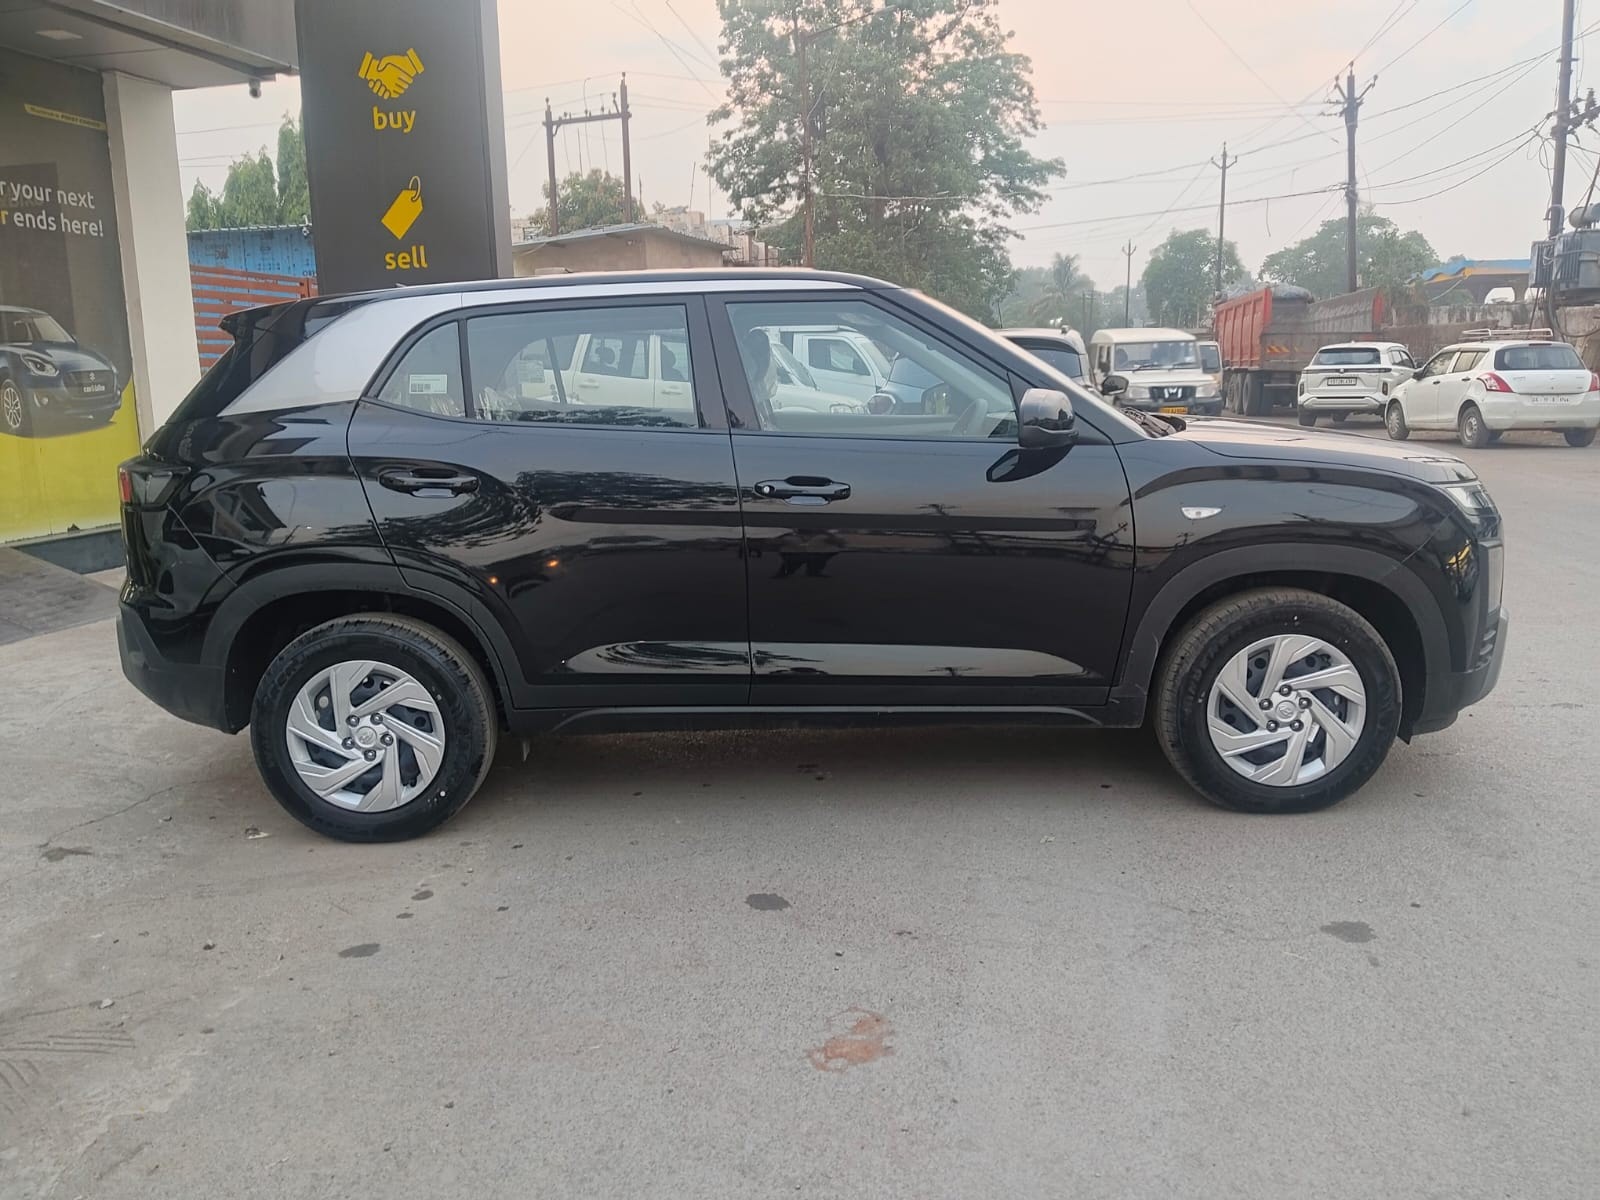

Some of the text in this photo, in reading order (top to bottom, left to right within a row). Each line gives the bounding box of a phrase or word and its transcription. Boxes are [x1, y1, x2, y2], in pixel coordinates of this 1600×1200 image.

[373, 106, 416, 133] buy
[10, 182, 52, 202] your
[57, 190, 95, 209] next
[13, 209, 57, 231] ends
[60, 212, 104, 237] here!
[384, 245, 428, 270] sell
